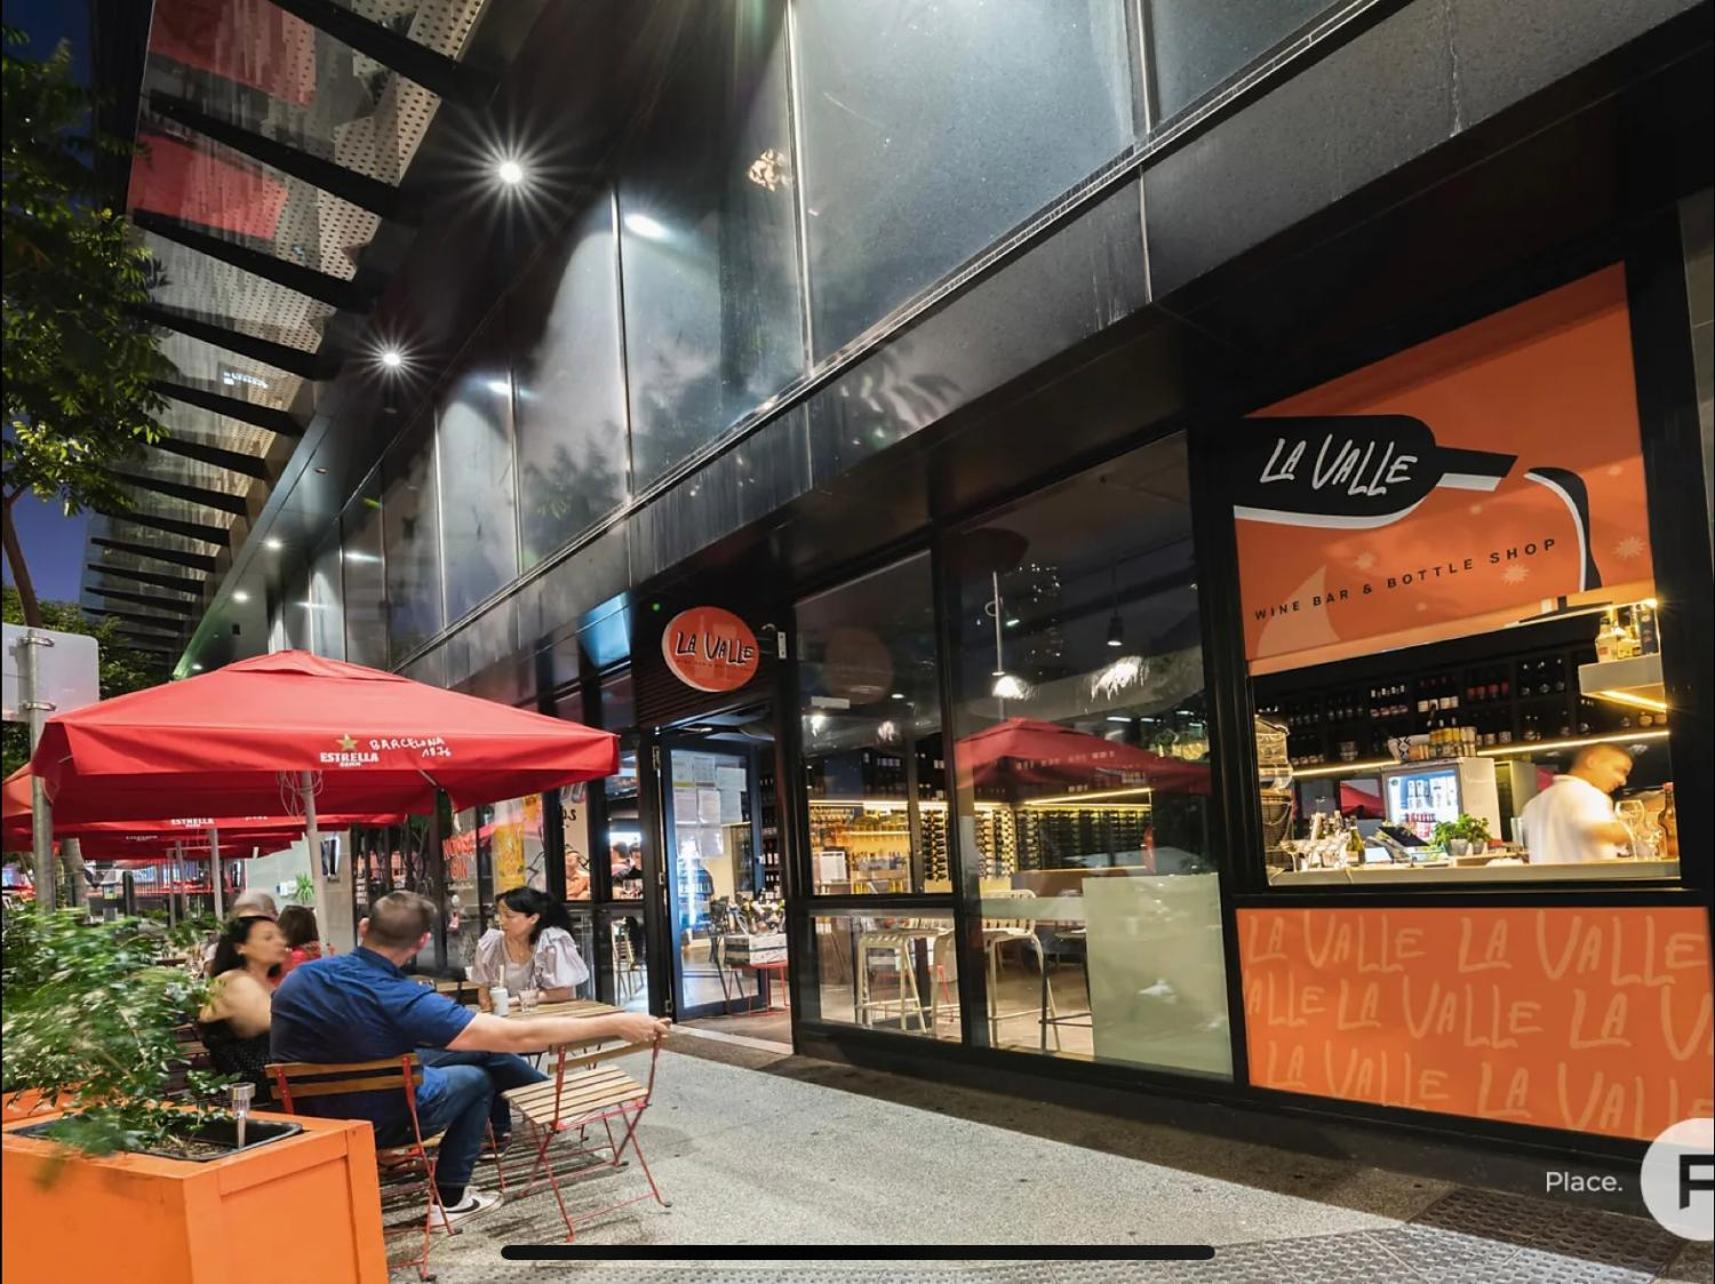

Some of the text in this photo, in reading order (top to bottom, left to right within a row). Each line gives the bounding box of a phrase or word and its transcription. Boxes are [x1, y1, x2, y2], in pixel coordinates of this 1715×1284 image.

[1260, 433, 1418, 496] LA VALLE
[1254, 538, 1556, 621] WINE BAR & BOTTLE SHOP
[675, 631, 698, 657] LA
[703, 631, 753, 666] VALLE
[320, 752, 379, 763] ESTRELLA
[369, 736, 445, 751] BARCELONA
[171, 817, 215, 826] ESTRELLA
[1249, 910, 1708, 986] LA VALLE LA VALLE
[1338, 979, 1382, 1030] LA
[1403, 975, 1544, 1049] VALLE
[1570, 988, 1633, 1050] LA
[1267, 1041, 1306, 1088] LA
[1476, 1062, 1532, 1118] LA
